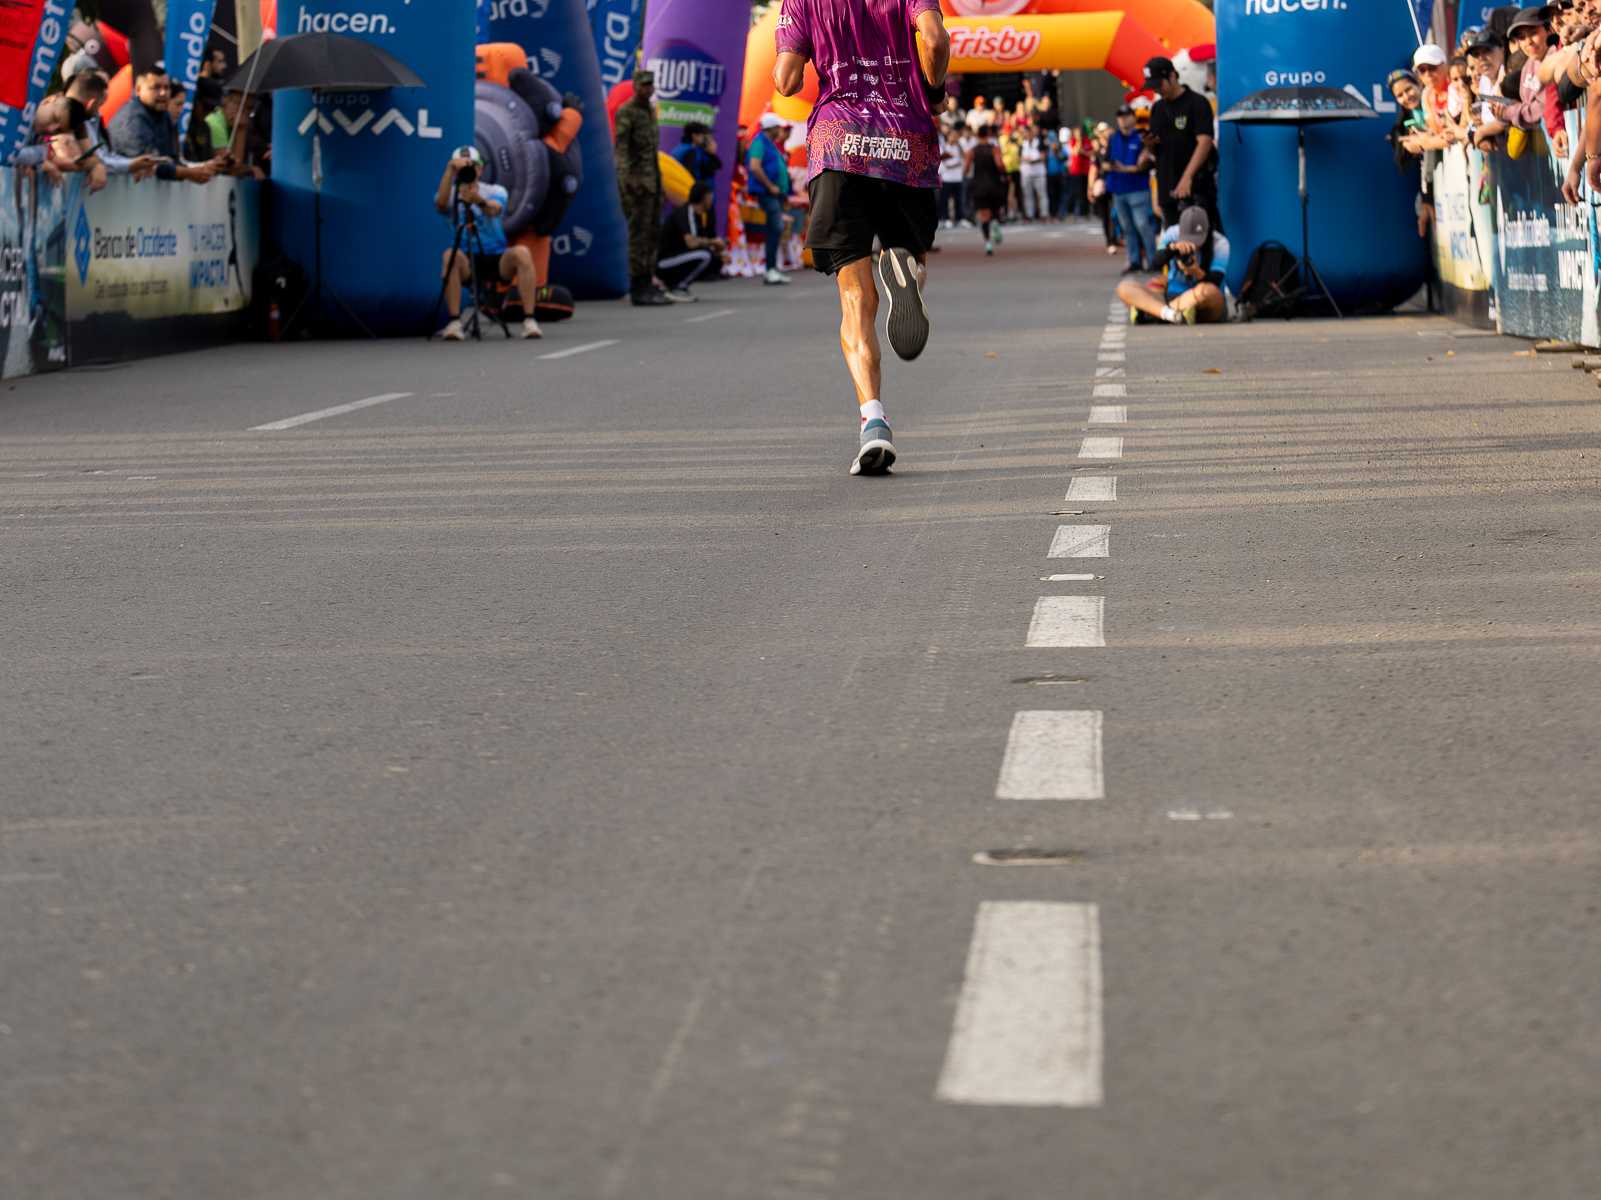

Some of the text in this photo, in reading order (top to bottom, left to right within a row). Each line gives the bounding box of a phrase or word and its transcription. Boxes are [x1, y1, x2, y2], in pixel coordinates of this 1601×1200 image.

[297, 5, 397, 34] hacen.
[180, 11, 206, 91] lado
[948, 26, 1041, 63] Frisby
[1264, 70, 1327, 86] Grupo
[297, 107, 443, 139] AVAL
[844, 133, 909, 150] DE PEREIRA
[869, 147, 911, 161] MUNDO
